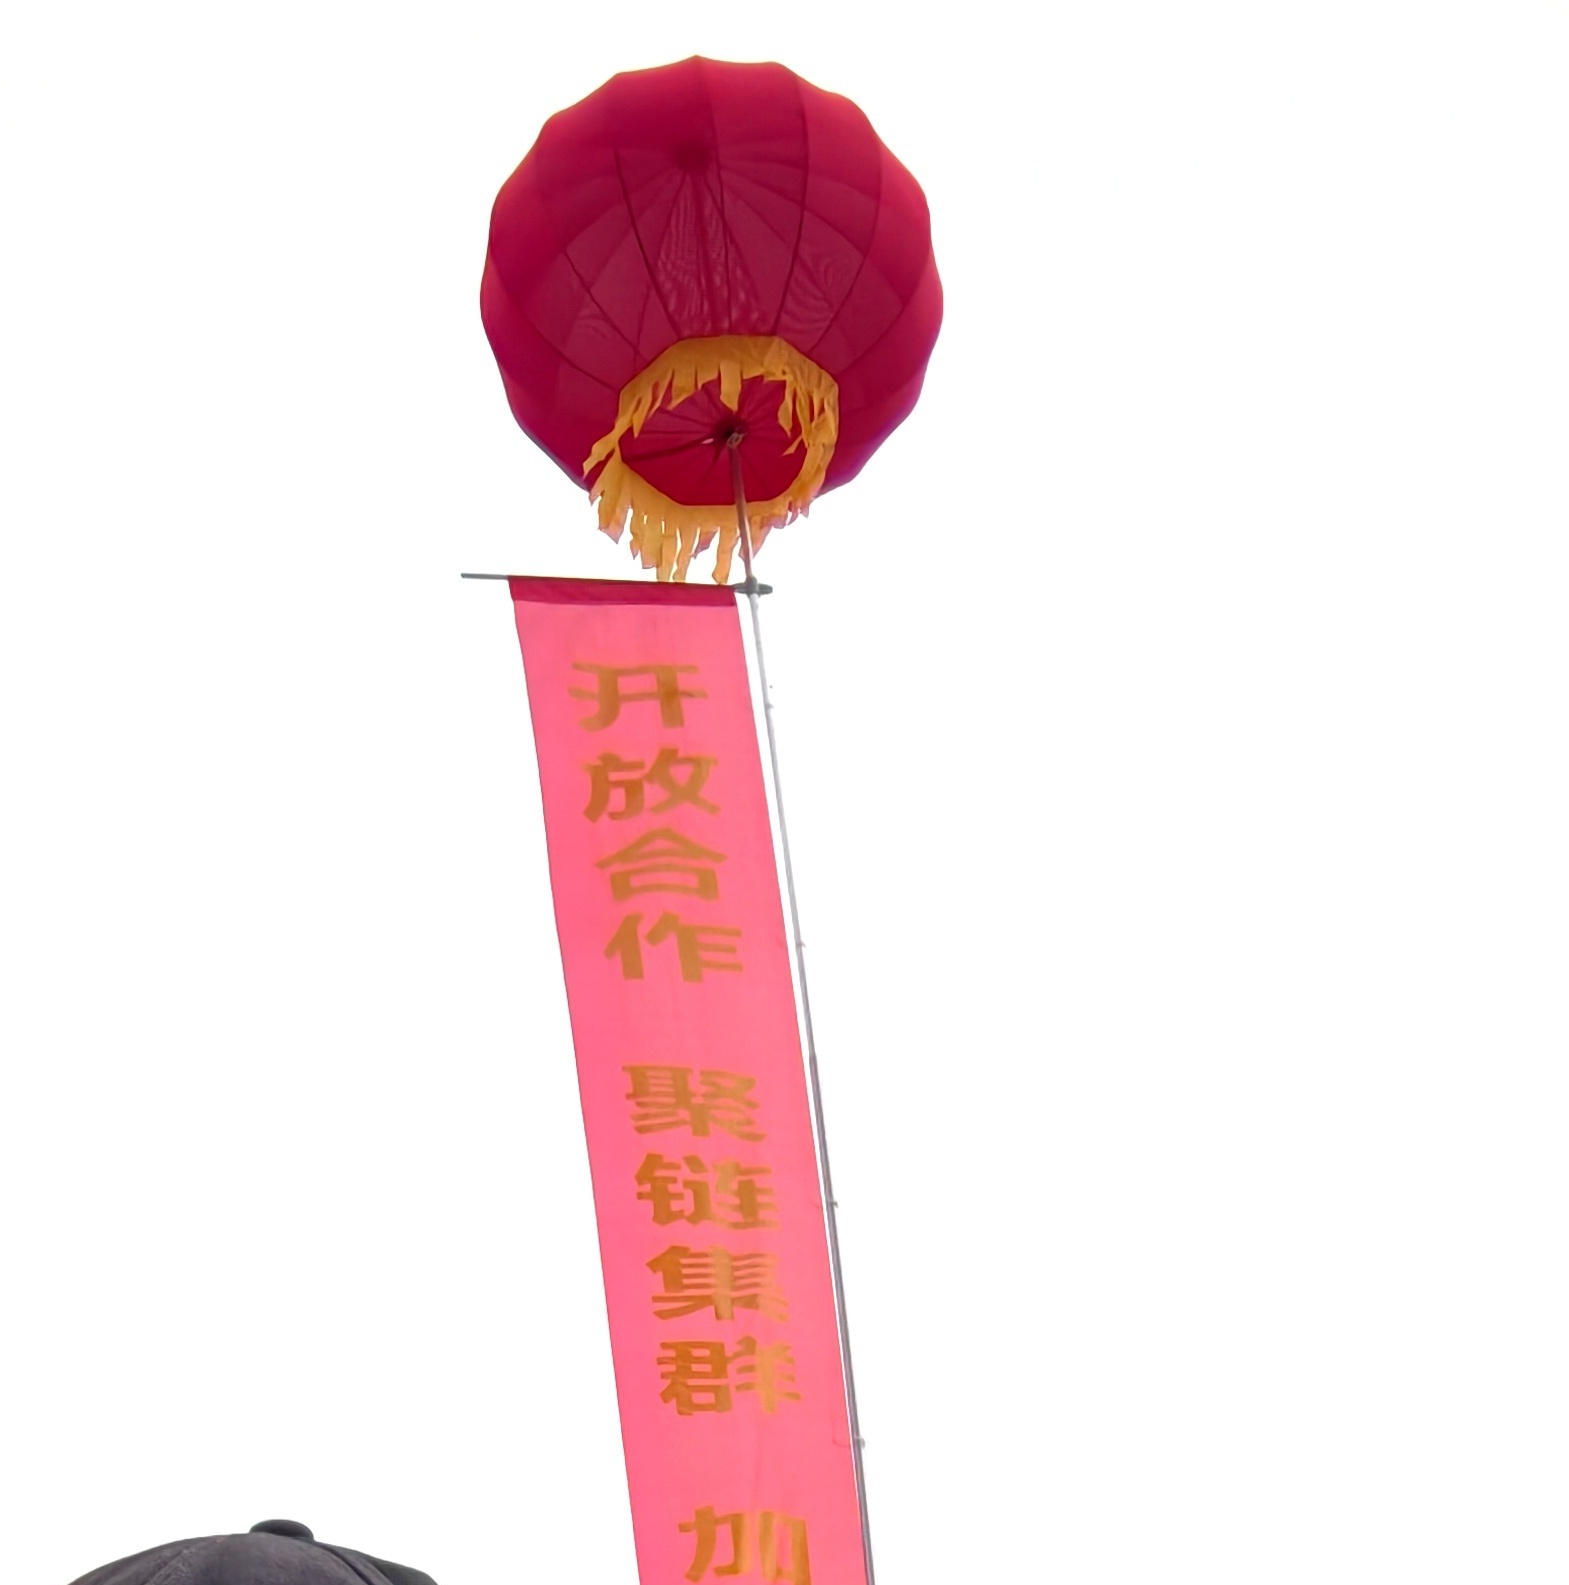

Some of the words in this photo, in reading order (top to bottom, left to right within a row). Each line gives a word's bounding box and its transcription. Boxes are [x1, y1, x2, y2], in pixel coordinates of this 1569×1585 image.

[567, 661, 743, 983] 开放合作
[620, 1064, 801, 1417] 聚链集群
